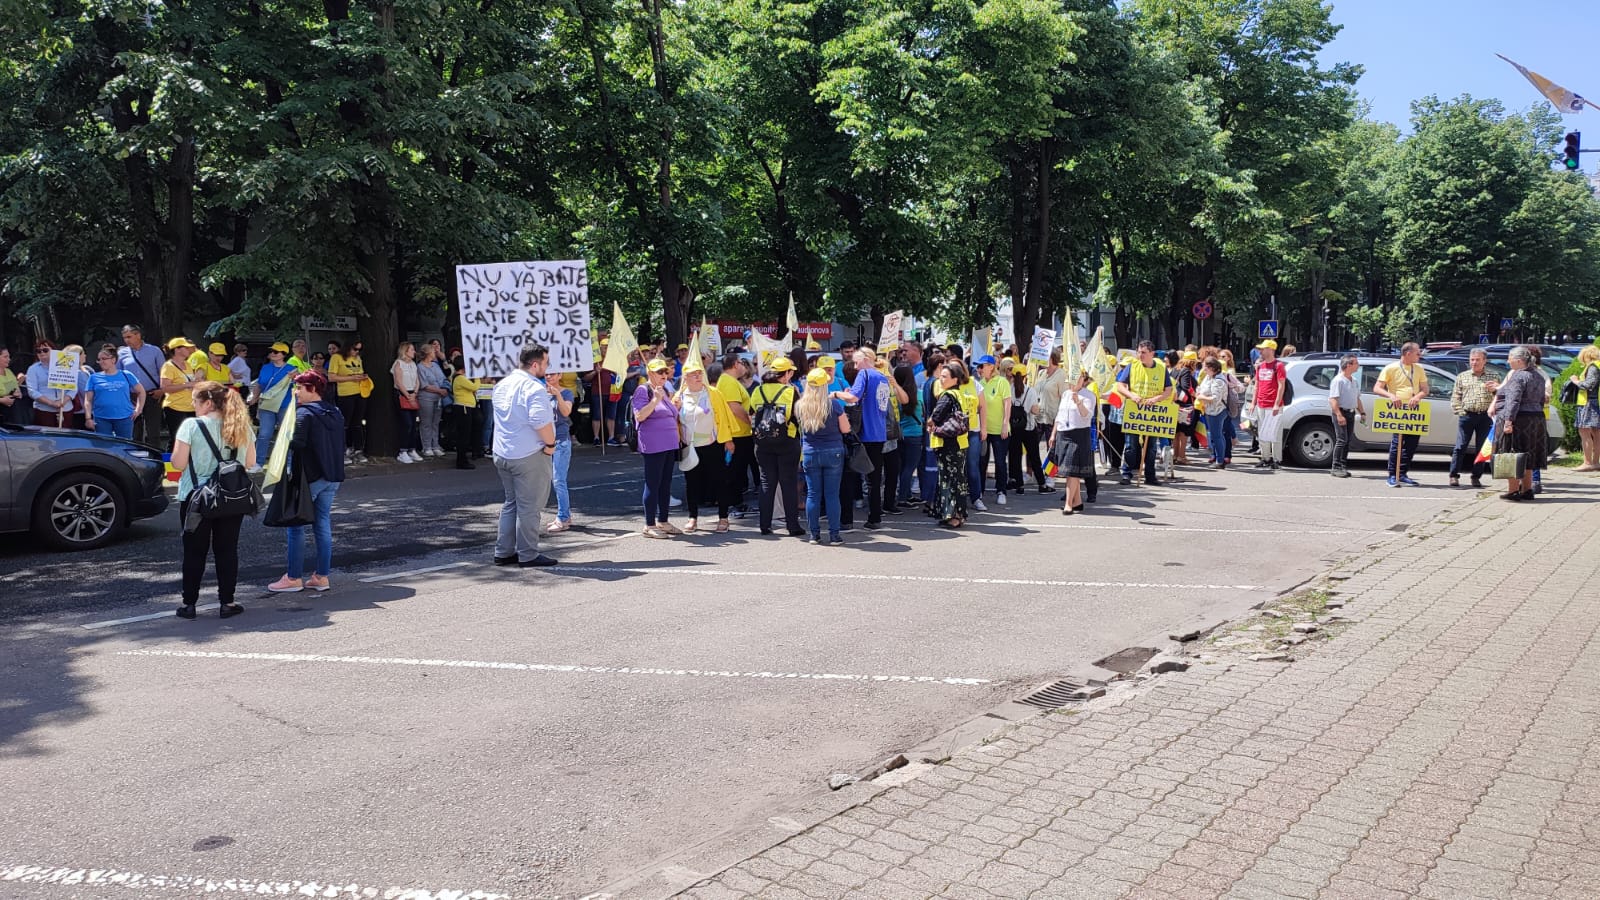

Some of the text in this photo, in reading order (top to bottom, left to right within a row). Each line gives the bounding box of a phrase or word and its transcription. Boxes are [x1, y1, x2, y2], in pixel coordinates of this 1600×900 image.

[459, 263, 588, 290] NU VĂ BATE
[488, 288, 520, 308] JOC
[524, 289, 551, 307] DE
[557, 290, 589, 308] EDU
[554, 308, 583, 327] DE
[564, 328, 590, 346] RO
[469, 352, 520, 377] MÂN
[1136, 403, 1168, 414] VREM
[1379, 411, 1426, 421] SALARII
[1129, 412, 1173, 424] SALARII
[1124, 422, 1176, 435] DECENTE
[1374, 421, 1429, 433] DECENTE
